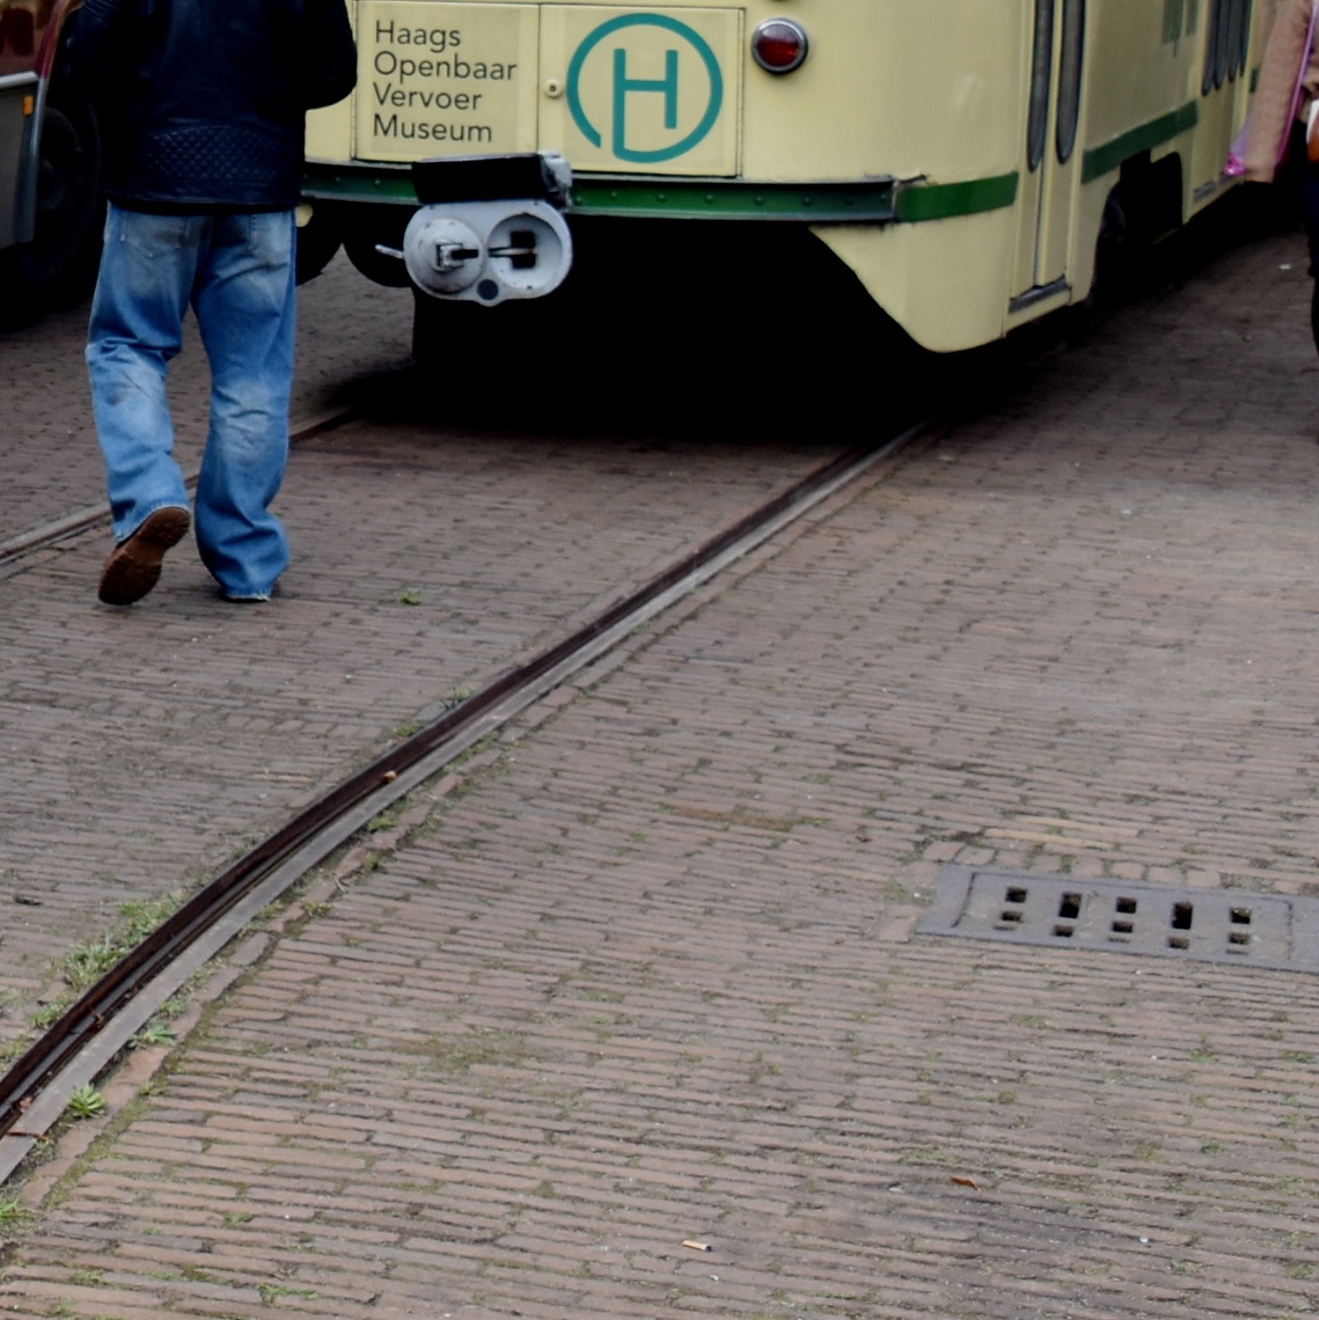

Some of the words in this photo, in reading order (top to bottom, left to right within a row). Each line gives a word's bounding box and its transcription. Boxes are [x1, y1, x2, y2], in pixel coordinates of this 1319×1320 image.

[375, 20, 461, 53] Haags
[374, 50, 517, 82] Openbaar
[373, 82, 483, 111] Vervoer
[373, 114, 493, 143] Museum
